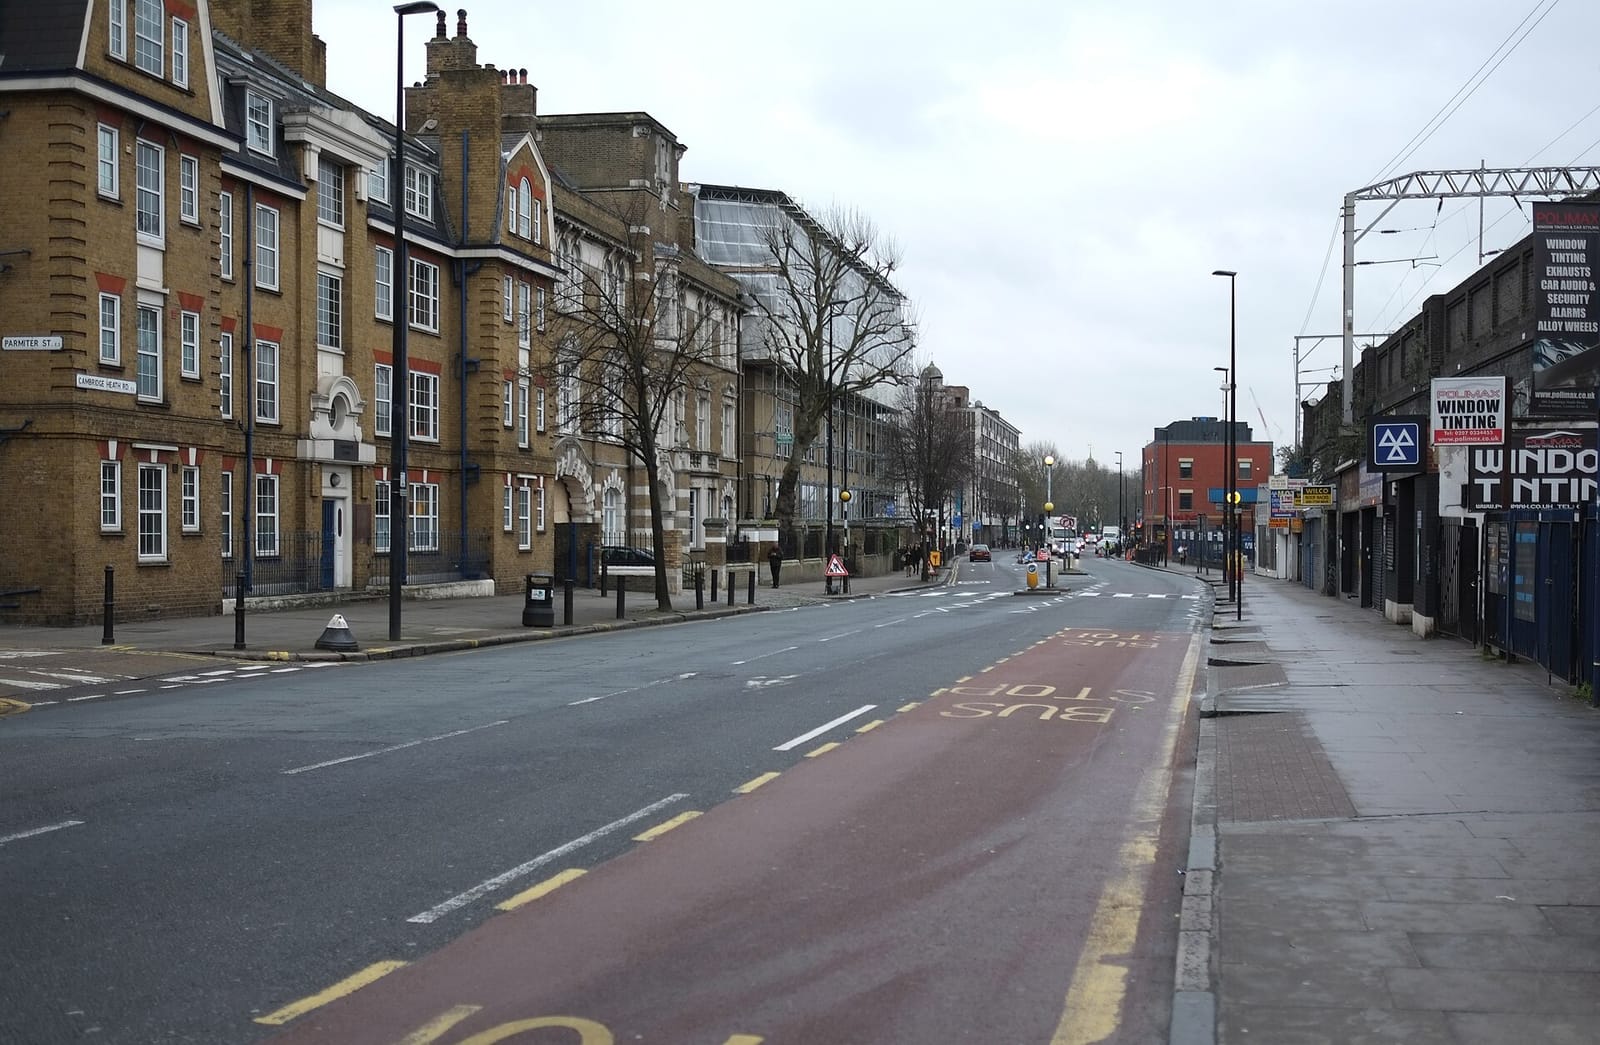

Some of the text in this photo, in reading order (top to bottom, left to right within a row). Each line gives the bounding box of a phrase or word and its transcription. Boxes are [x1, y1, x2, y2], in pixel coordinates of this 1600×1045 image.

[1536, 210, 1599, 225] POLIMAX
[1546, 239, 1586, 250] WINDOW
[1551, 252, 1586, 263] TINTING
[1546, 266, 1591, 277] EXHAUSTS
[1541, 280, 1596, 291] CAR AUDIO &
[1547, 293, 1590, 304] SECURITY
[1550, 307, 1586, 318] ALARMS
[1538, 320, 1598, 332] ALLOY WHEELS
[1436, 389, 1501, 399] POLIMAX
[1437, 400, 1500, 414] WINDOW
[1440, 415, 1497, 429] TINTING
[1474, 478, 1598, 502] TNTIN
[950, 684, 1156, 704] STOP
[939, 702, 1115, 724] BUS
